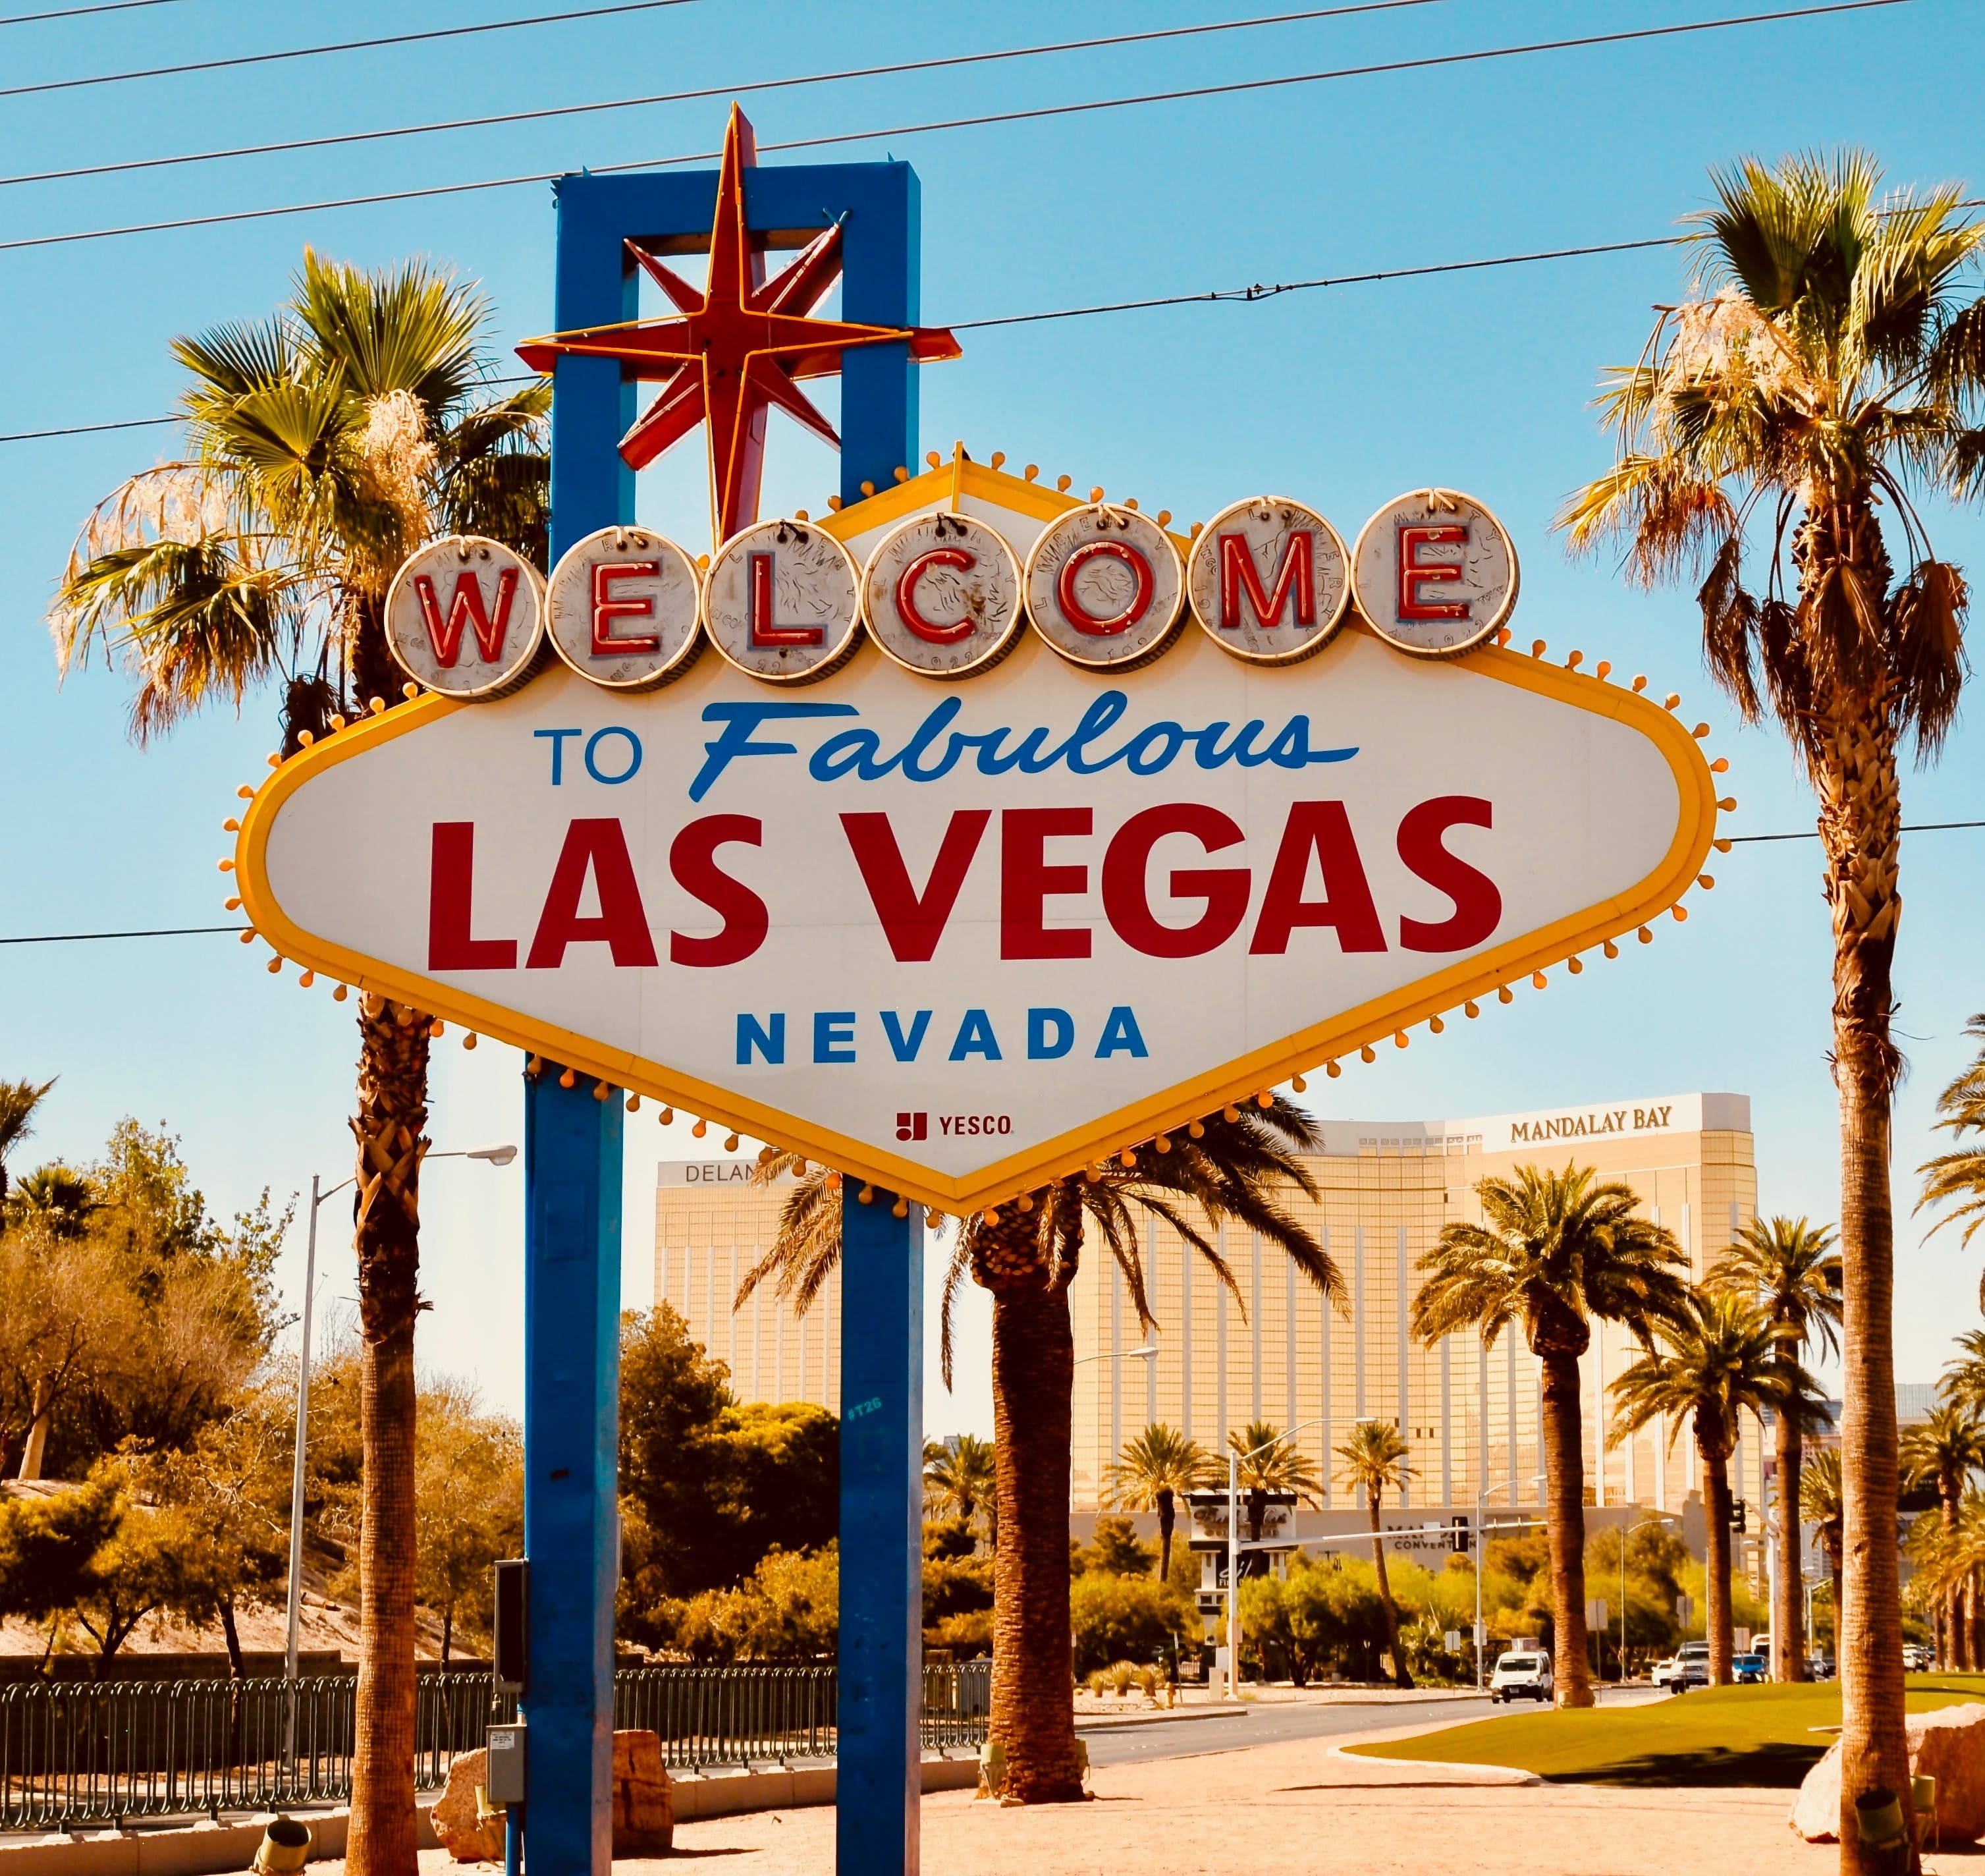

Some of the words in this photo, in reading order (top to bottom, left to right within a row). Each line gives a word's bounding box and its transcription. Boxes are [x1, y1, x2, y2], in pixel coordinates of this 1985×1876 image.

[414, 526, 1469, 668] WELCOME
[533, 727, 643, 786] TO
[689, 691, 1359, 803] Fabulous
[428, 814, 769, 971] LAS
[840, 796, 1502, 962] VEGAS
[736, 1006, 1149, 1065] NEVADA
[939, 1115, 1012, 1136] YESCO
[1510, 1111, 1628, 1144] MANDALAY
[1633, 1105, 1673, 1130] BAY
[686, 1164, 772, 1182] DELAN
[1394, 1540, 1477, 1550] CONVENTN
